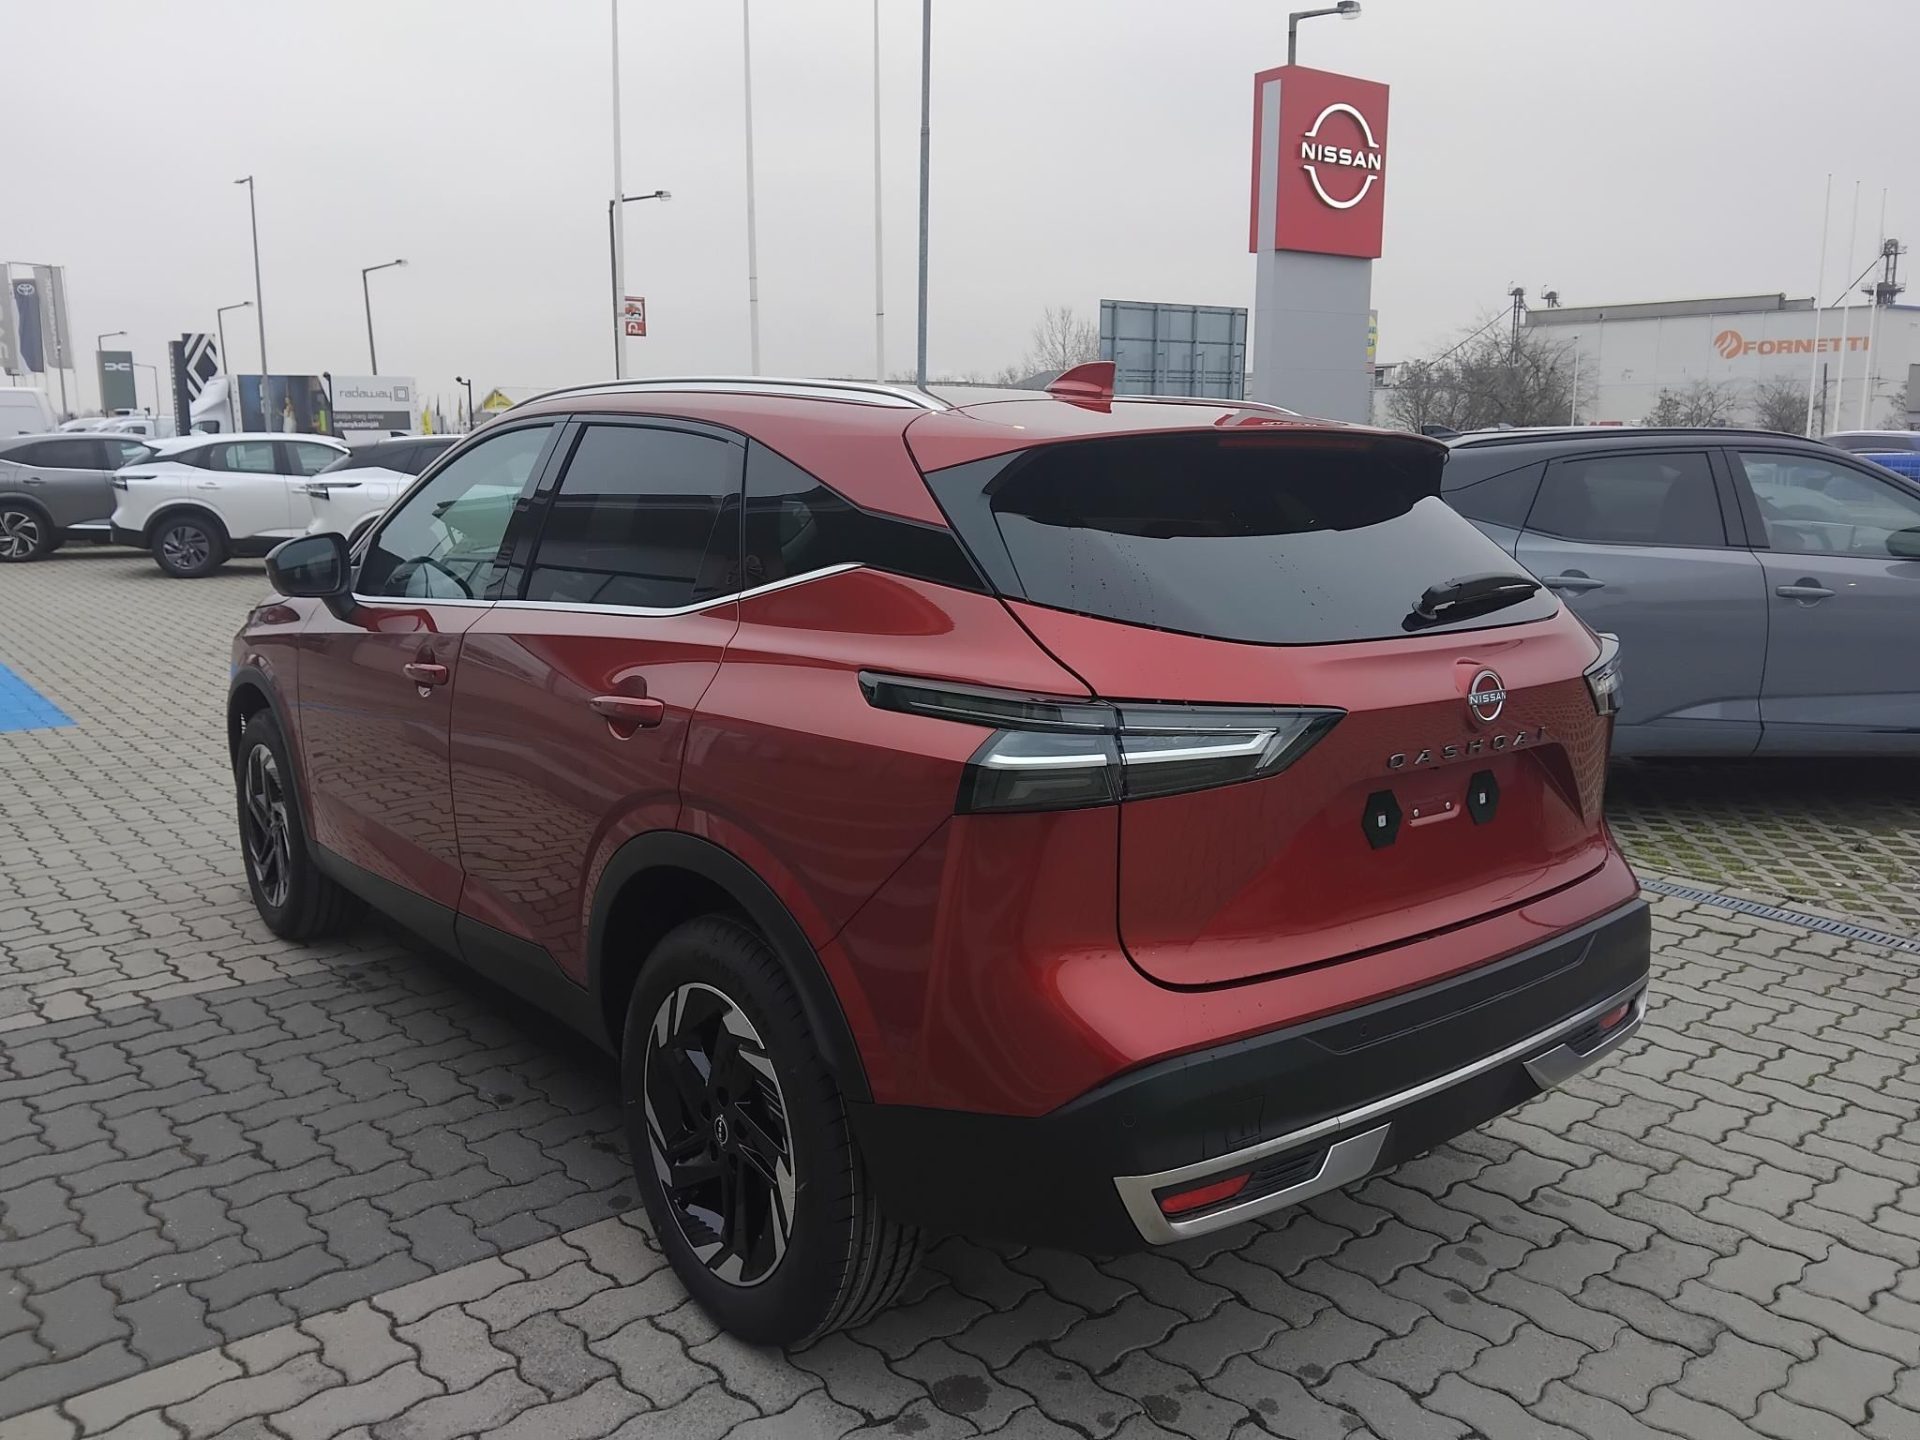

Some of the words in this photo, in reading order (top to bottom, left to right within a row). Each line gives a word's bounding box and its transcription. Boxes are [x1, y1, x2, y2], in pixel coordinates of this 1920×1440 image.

[1301, 141, 1381, 170] NISSAN
[1743, 336, 1870, 355] FORNETTI
[339, 385, 392, 401] radaway
[1470, 691, 1506, 704] NISSAN
